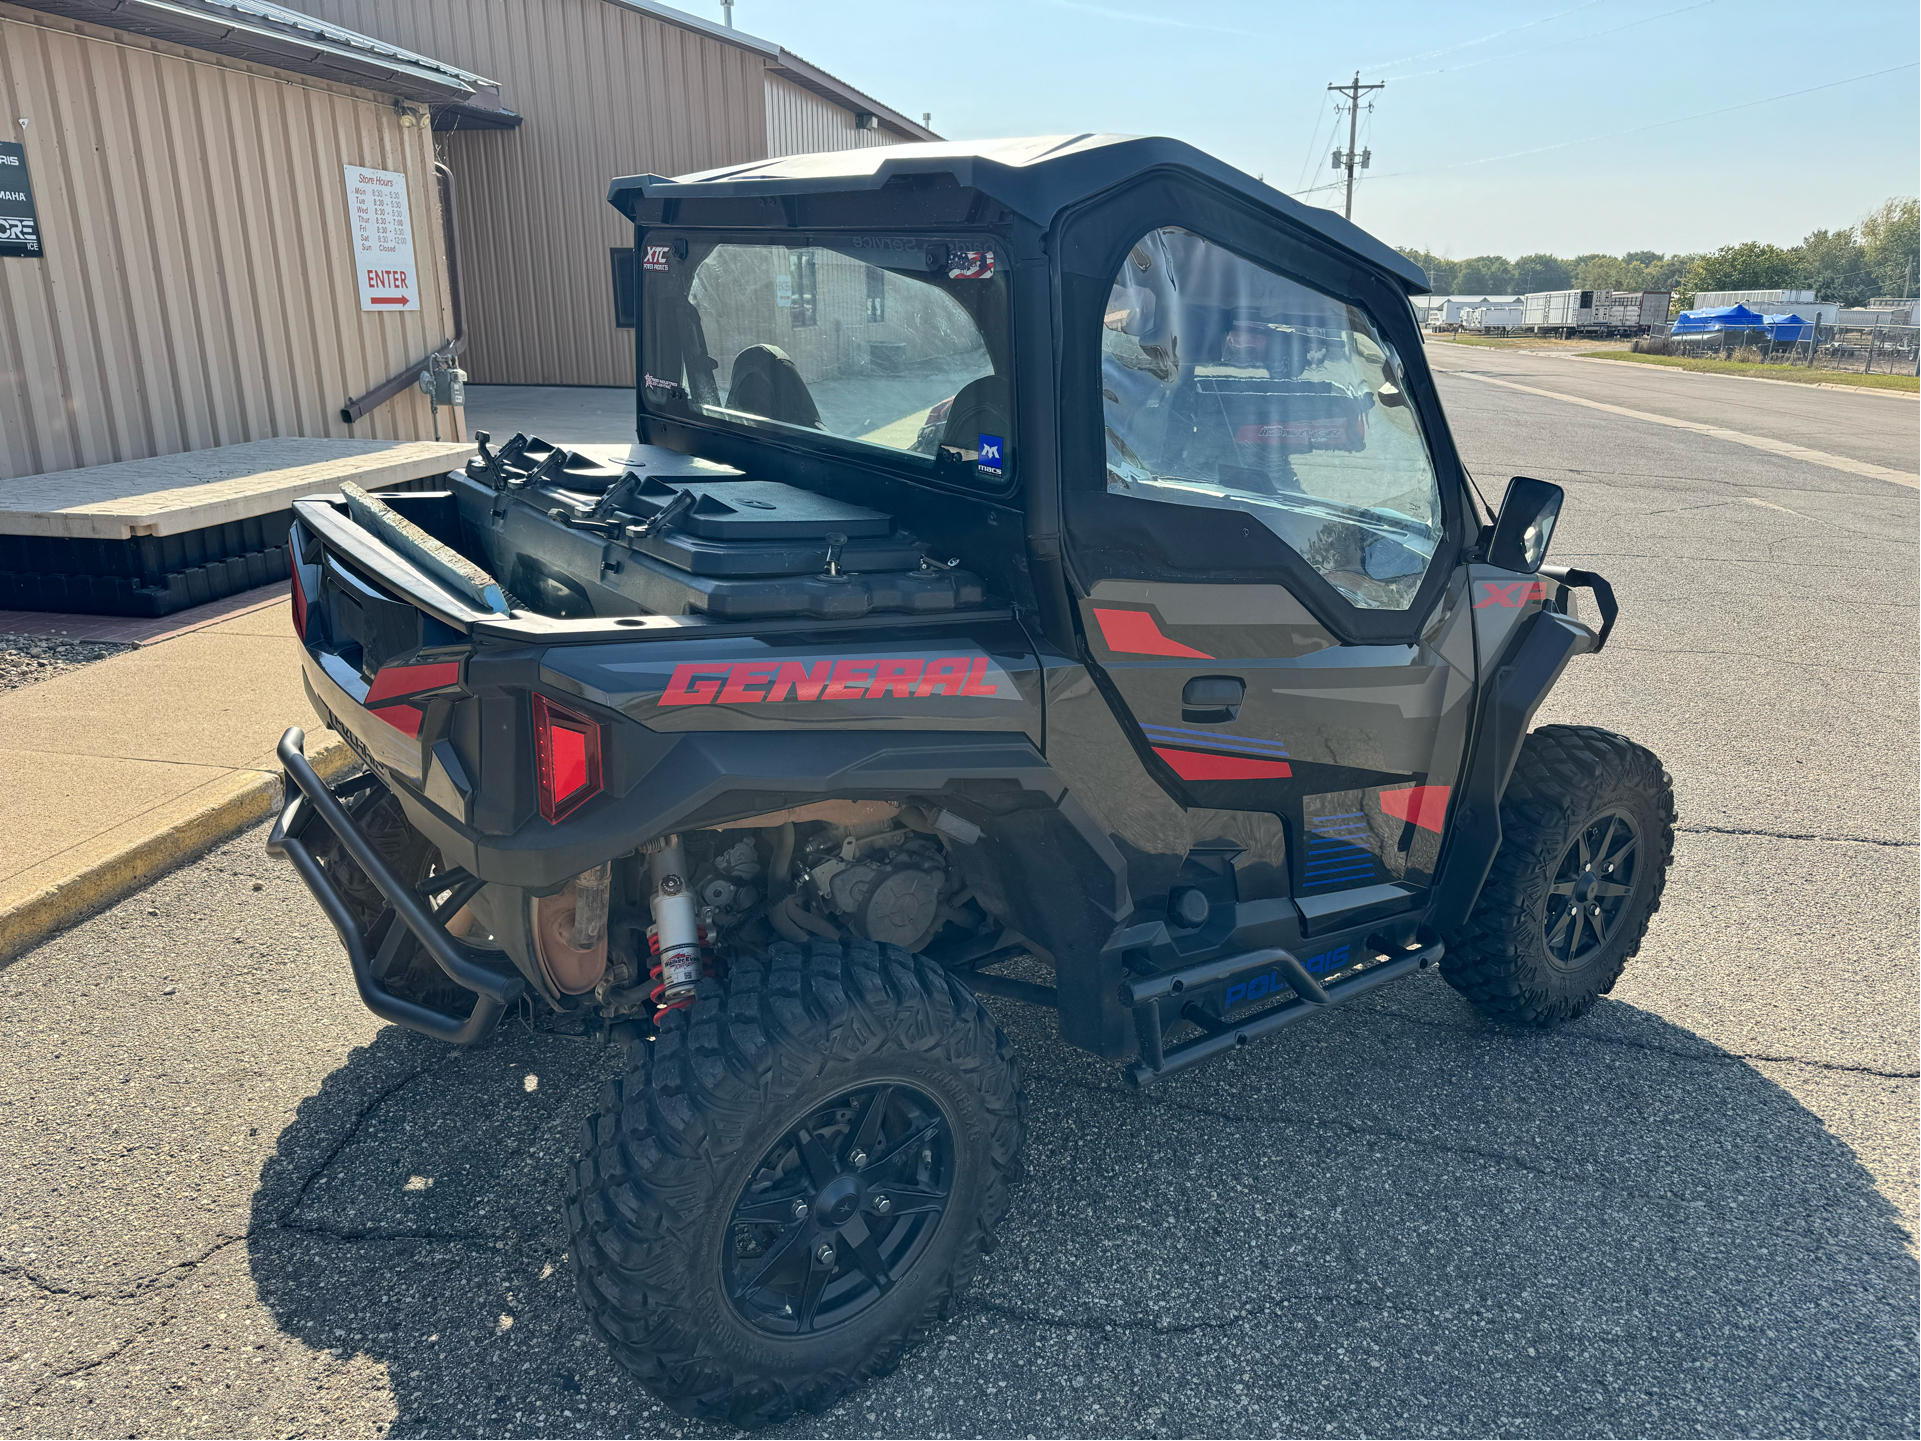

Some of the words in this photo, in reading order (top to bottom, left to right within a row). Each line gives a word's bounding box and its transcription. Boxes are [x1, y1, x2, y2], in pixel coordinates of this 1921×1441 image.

[359, 173, 375, 185] Store
[376, 176, 394, 187] Hours
[355, 187, 367, 196] Mon
[372, 189, 383, 198] 8:30
[389, 191, 400, 200] 5:30
[356, 196, 366, 205] Tue
[373, 198, 385, 207] 8:30
[391, 200, 401, 209] 5:30
[357, 205, 369, 214] Wed
[375, 207, 386, 216] 8:30
[392, 209, 403, 218] 5:30
[358, 214, 370, 224] Thur
[376, 216, 387, 225] 8:30
[392, 218, 404, 227] 7:00
[377, 225, 388, 234] 8:30
[394, 227, 405, 236] 5:30
[361, 233, 370, 242] Sat
[378, 235, 389, 244] 8:30
[394, 236, 407, 245] 12:00
[27, 242, 39, 251] ICE
[362, 242, 372, 251] Sun
[379, 244, 396, 253] Closed
[643, 246, 670, 264] XTC
[366, 269, 409, 289] ENTER
[977, 464, 1002, 475] macs
[1471, 581, 1548, 609] XP
[657, 656, 999, 707] GENERAL
[1224, 944, 1350, 1010] POLRIS
